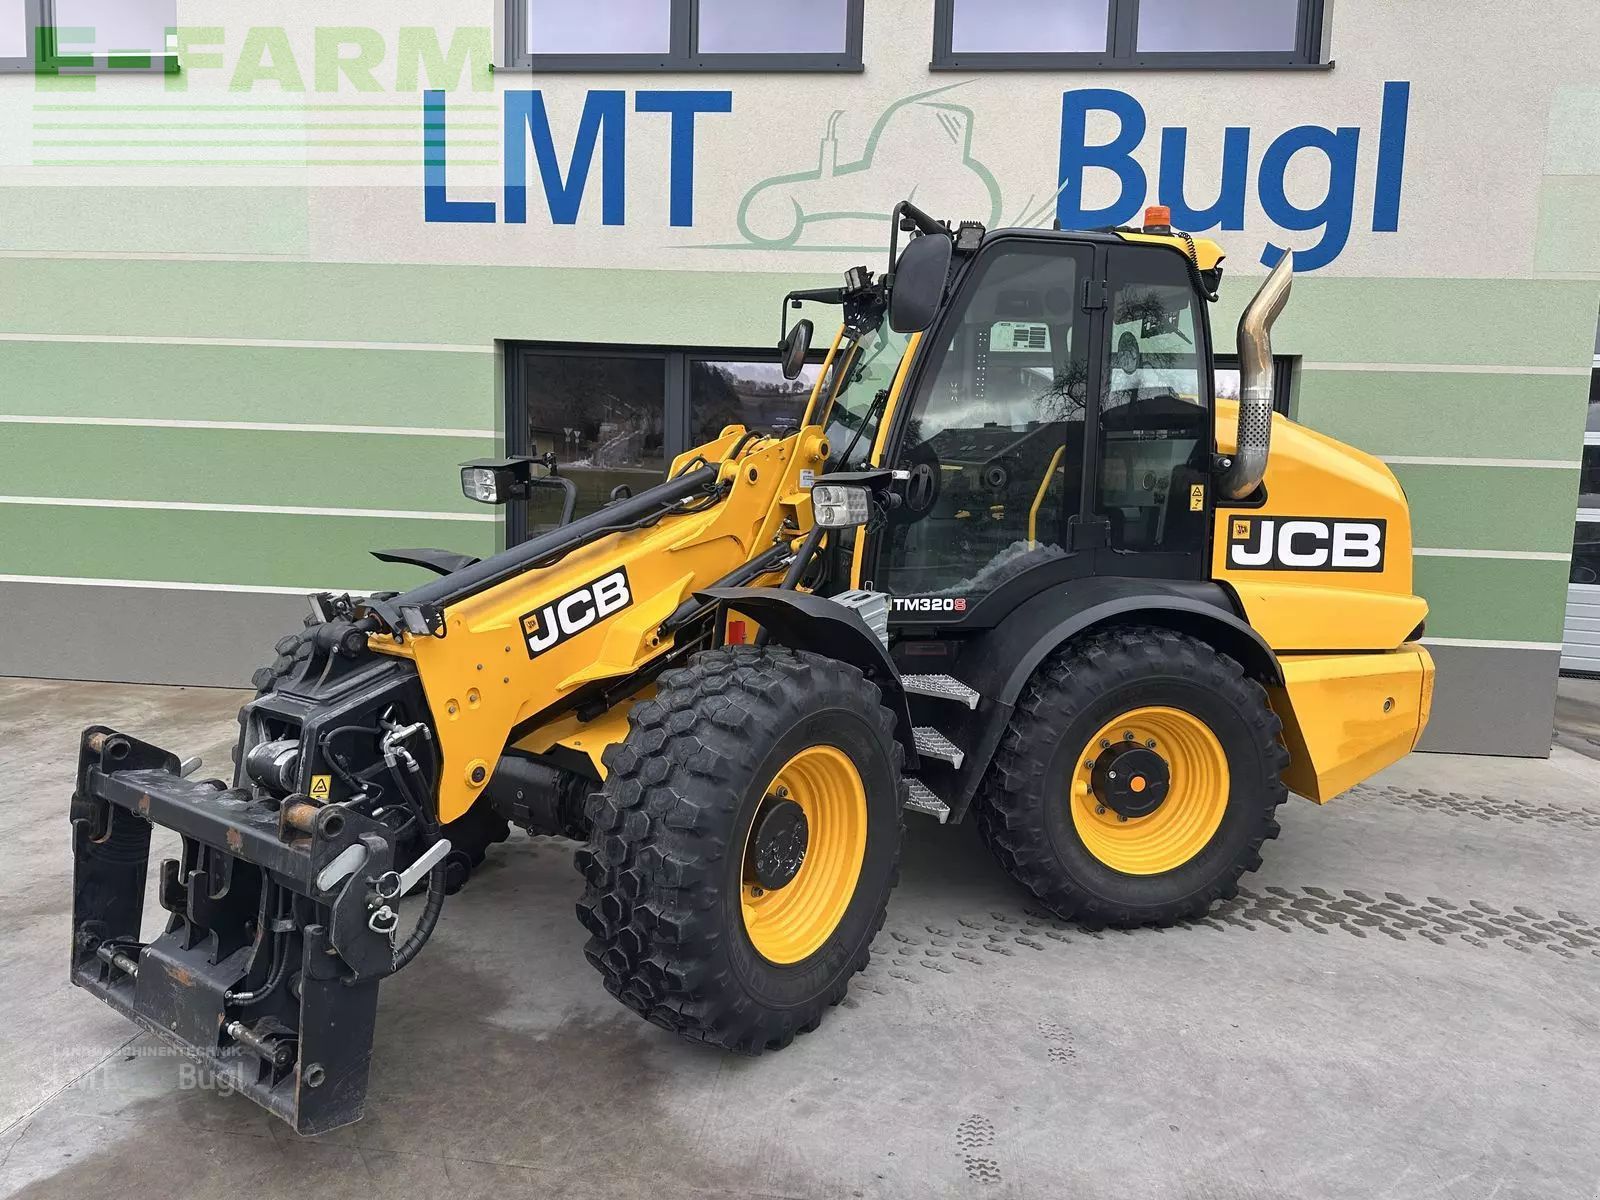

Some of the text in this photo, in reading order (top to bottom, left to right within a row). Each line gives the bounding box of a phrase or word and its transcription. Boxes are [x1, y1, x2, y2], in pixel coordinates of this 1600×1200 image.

[423, 80, 1411, 273] LMT Bugl
[1231, 520, 1381, 568] JCB
[528, 572, 630, 652] JCB
